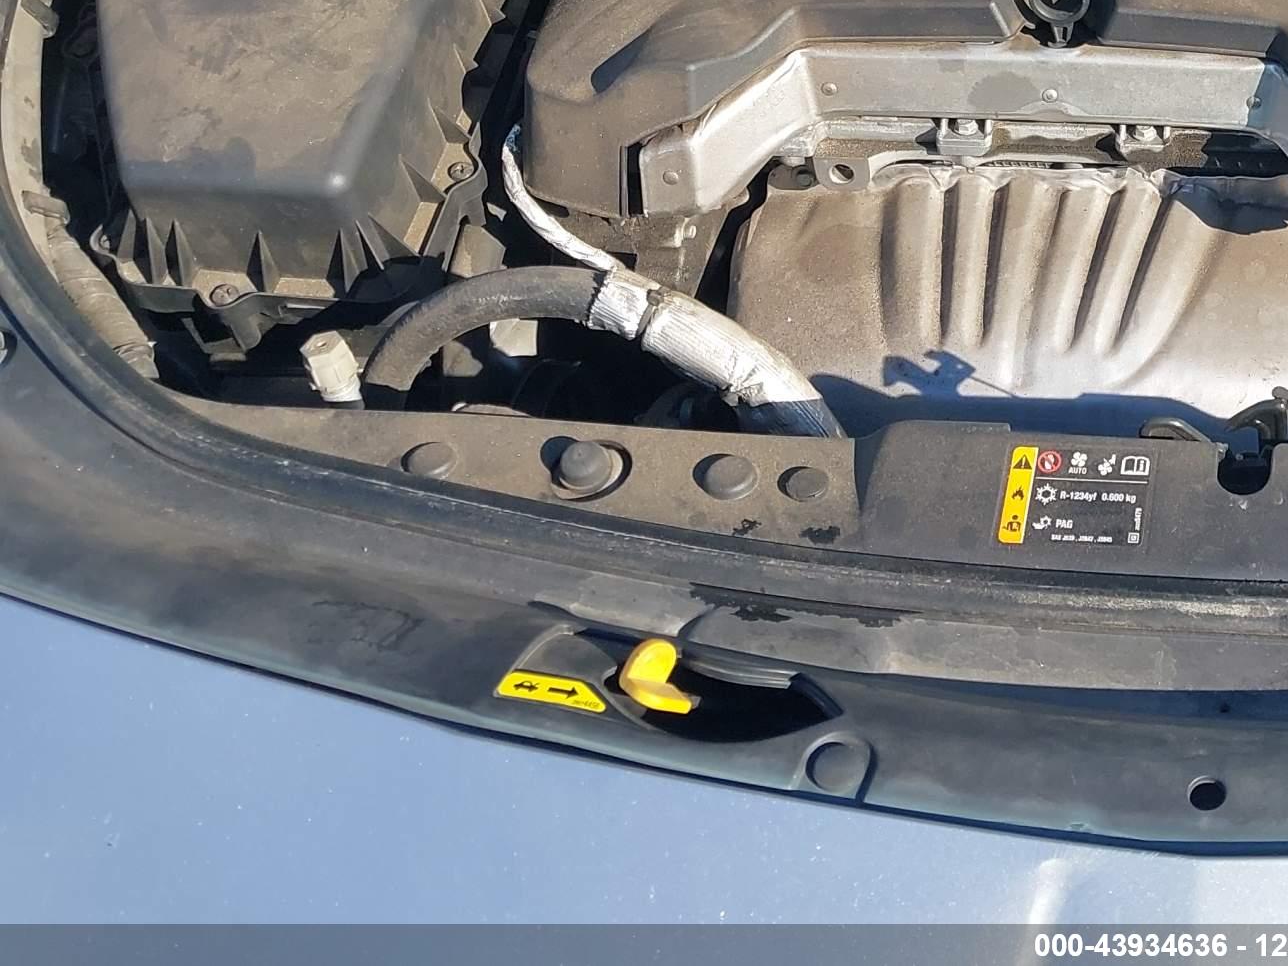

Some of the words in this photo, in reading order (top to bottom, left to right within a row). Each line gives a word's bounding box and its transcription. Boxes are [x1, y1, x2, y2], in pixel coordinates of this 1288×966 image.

[1068, 466, 1088, 475] AUTO
[1059, 490, 1097, 502] R-1234yf
[1125, 493, 1137, 504] kg
[1055, 518, 1074, 529] PAG
